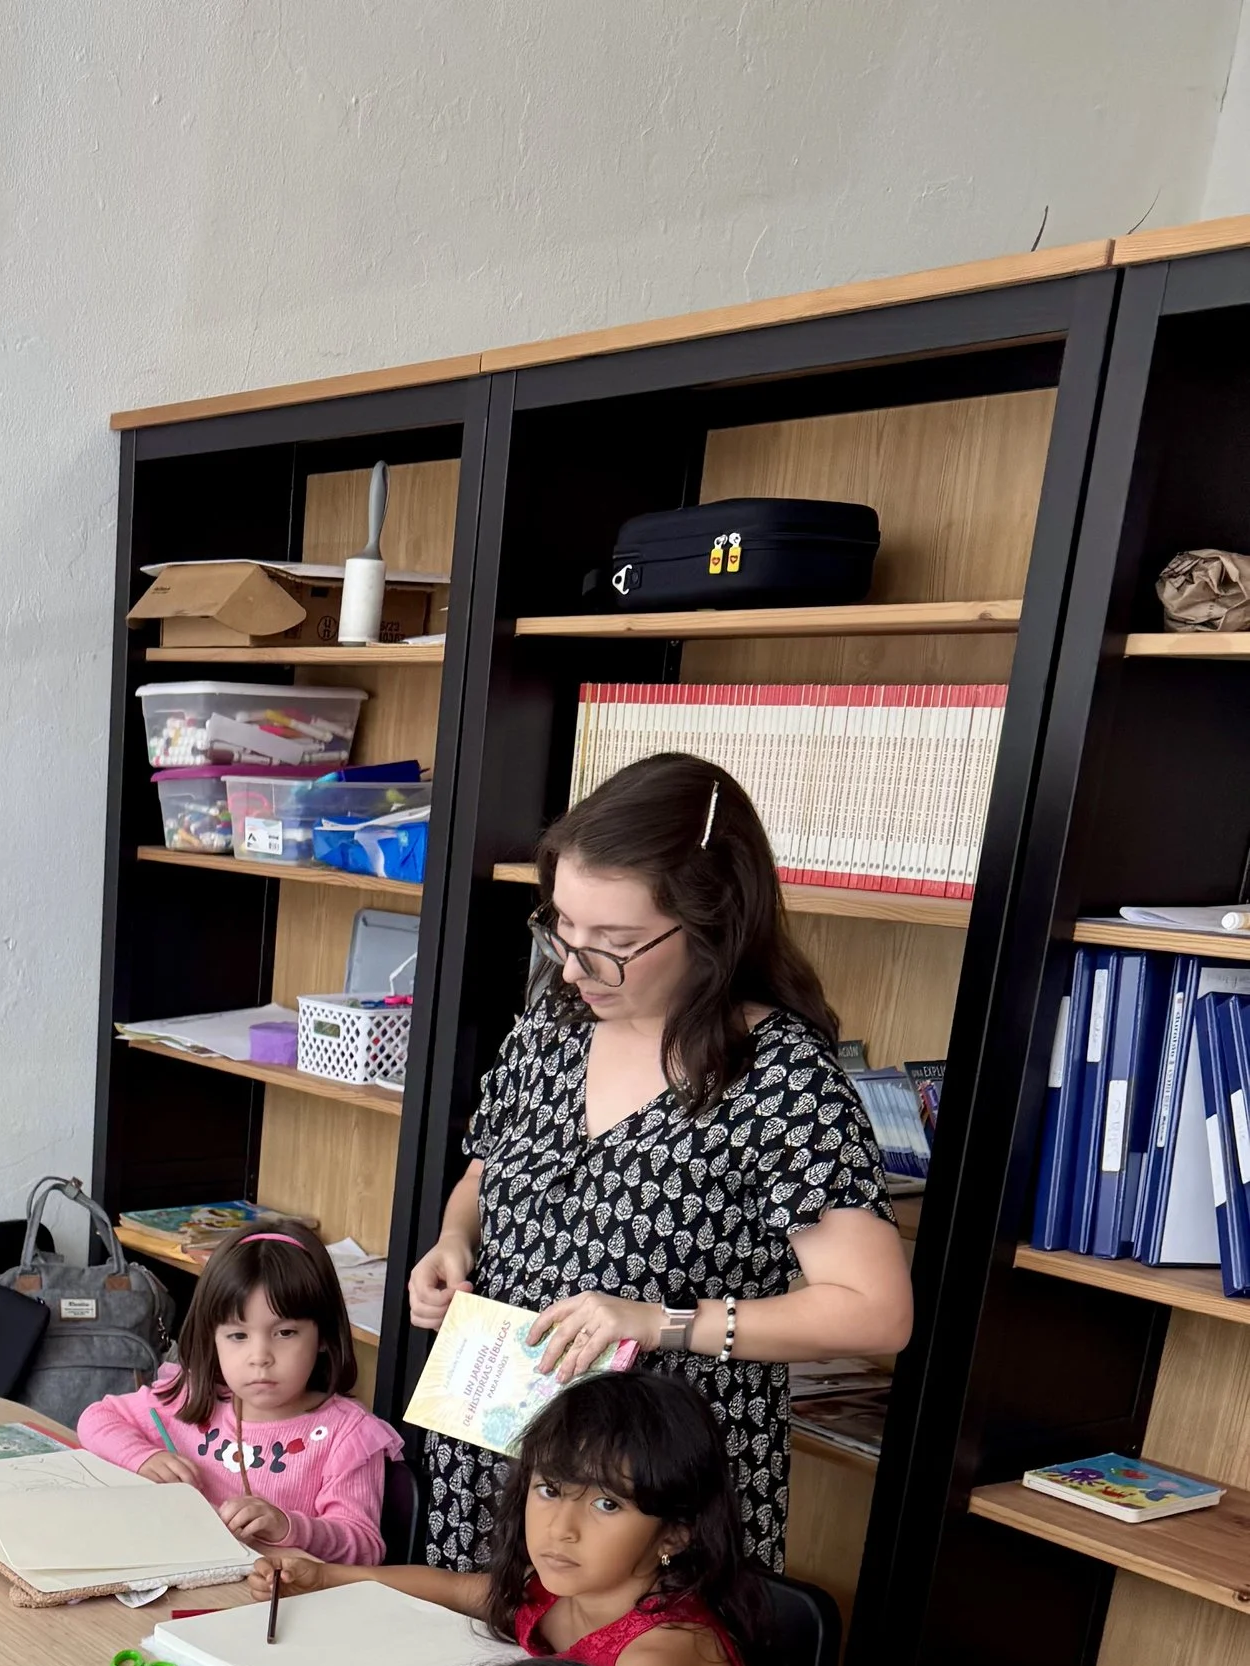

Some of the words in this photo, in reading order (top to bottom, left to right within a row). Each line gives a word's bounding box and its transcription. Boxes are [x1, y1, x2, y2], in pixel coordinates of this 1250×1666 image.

[923, 1064, 945, 1078] EXPLI
[488, 1319, 512, 1364] BÍBLICAS
[463, 1380, 475, 1396] UN
[471, 1344, 490, 1382] JARDÍN
[467, 1364, 493, 1414] HISTORIAS
[463, 1414, 474, 1427] DE
